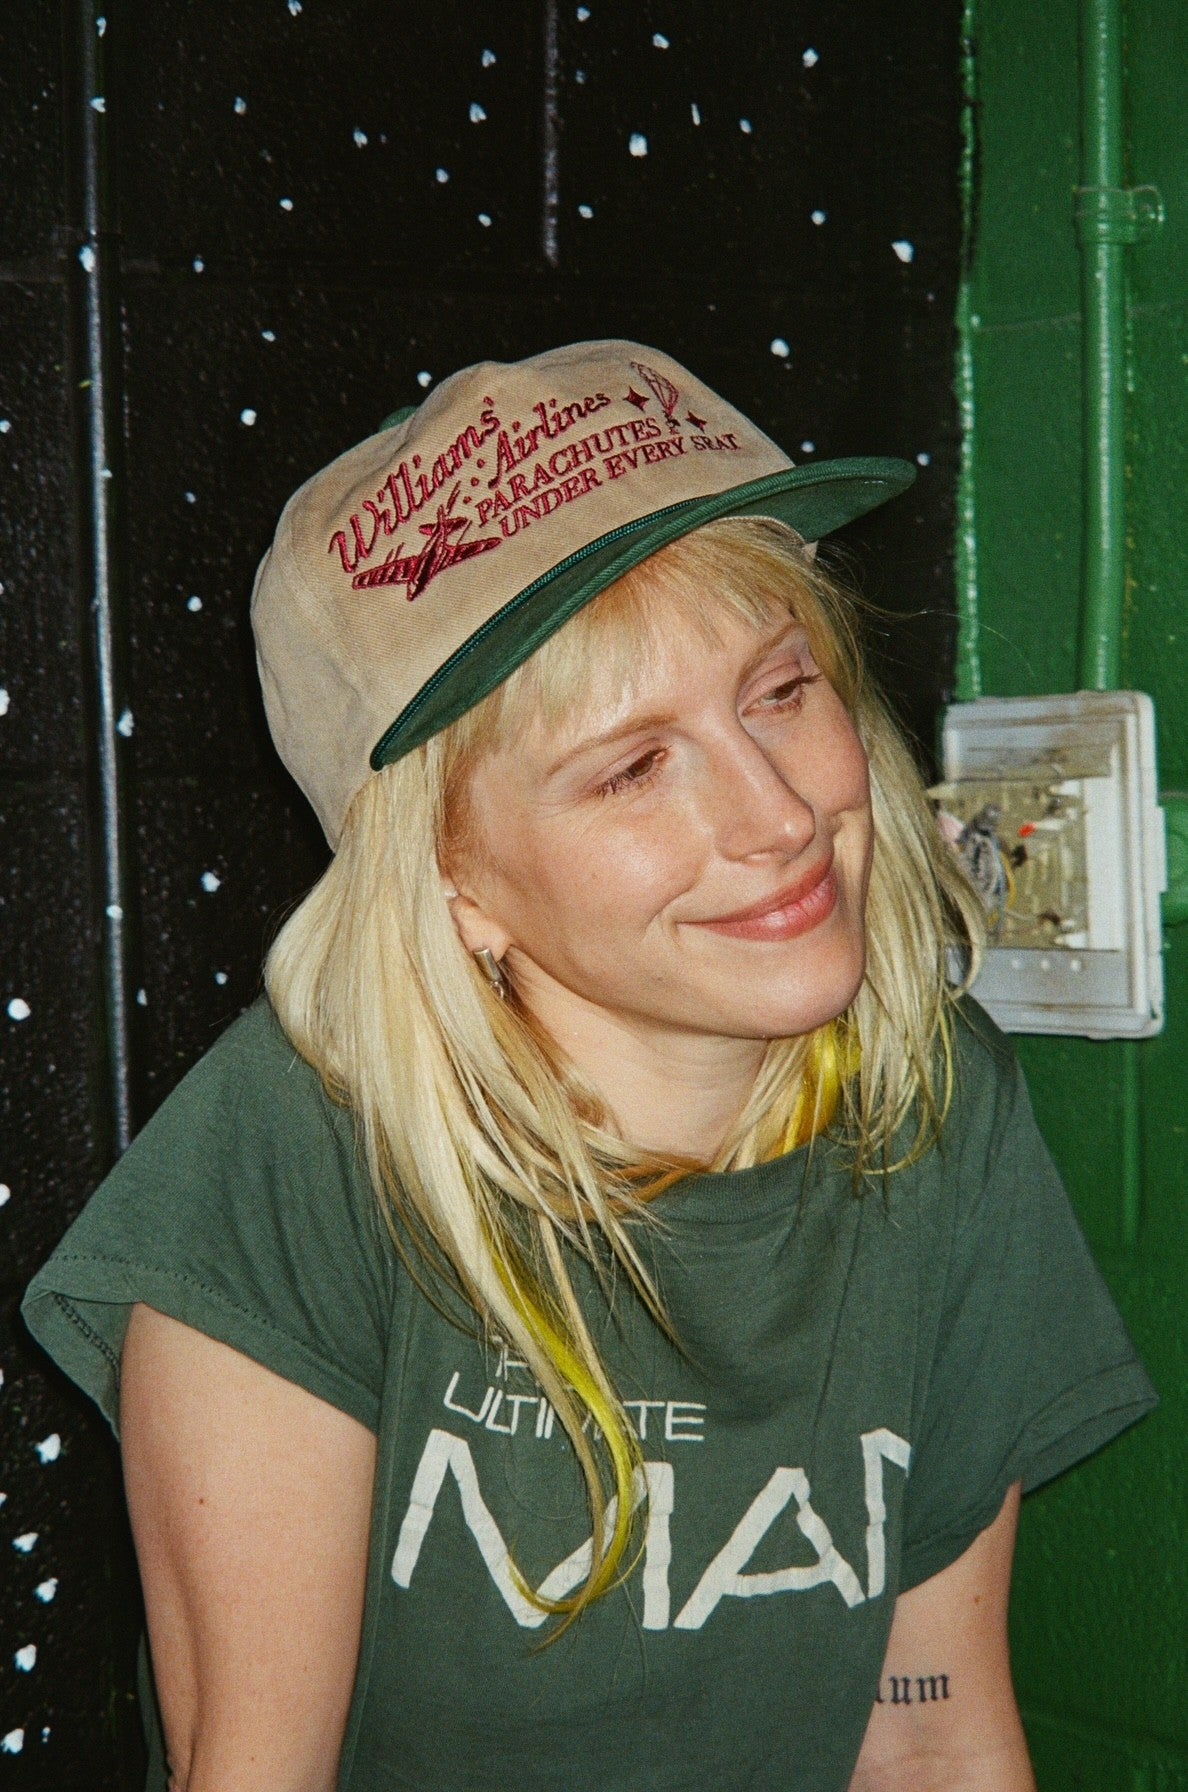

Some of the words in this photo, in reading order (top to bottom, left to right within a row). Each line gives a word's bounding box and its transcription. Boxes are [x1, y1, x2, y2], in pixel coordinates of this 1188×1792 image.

[474, 417, 662, 529] PARACHUTES
[487, 392, 612, 490] Airlines
[498, 467, 604, 538] UNDER
[602, 435, 688, 480] EVERY
[443, 1370, 708, 1442] ULTITE
[875, 1672, 950, 1705] um
